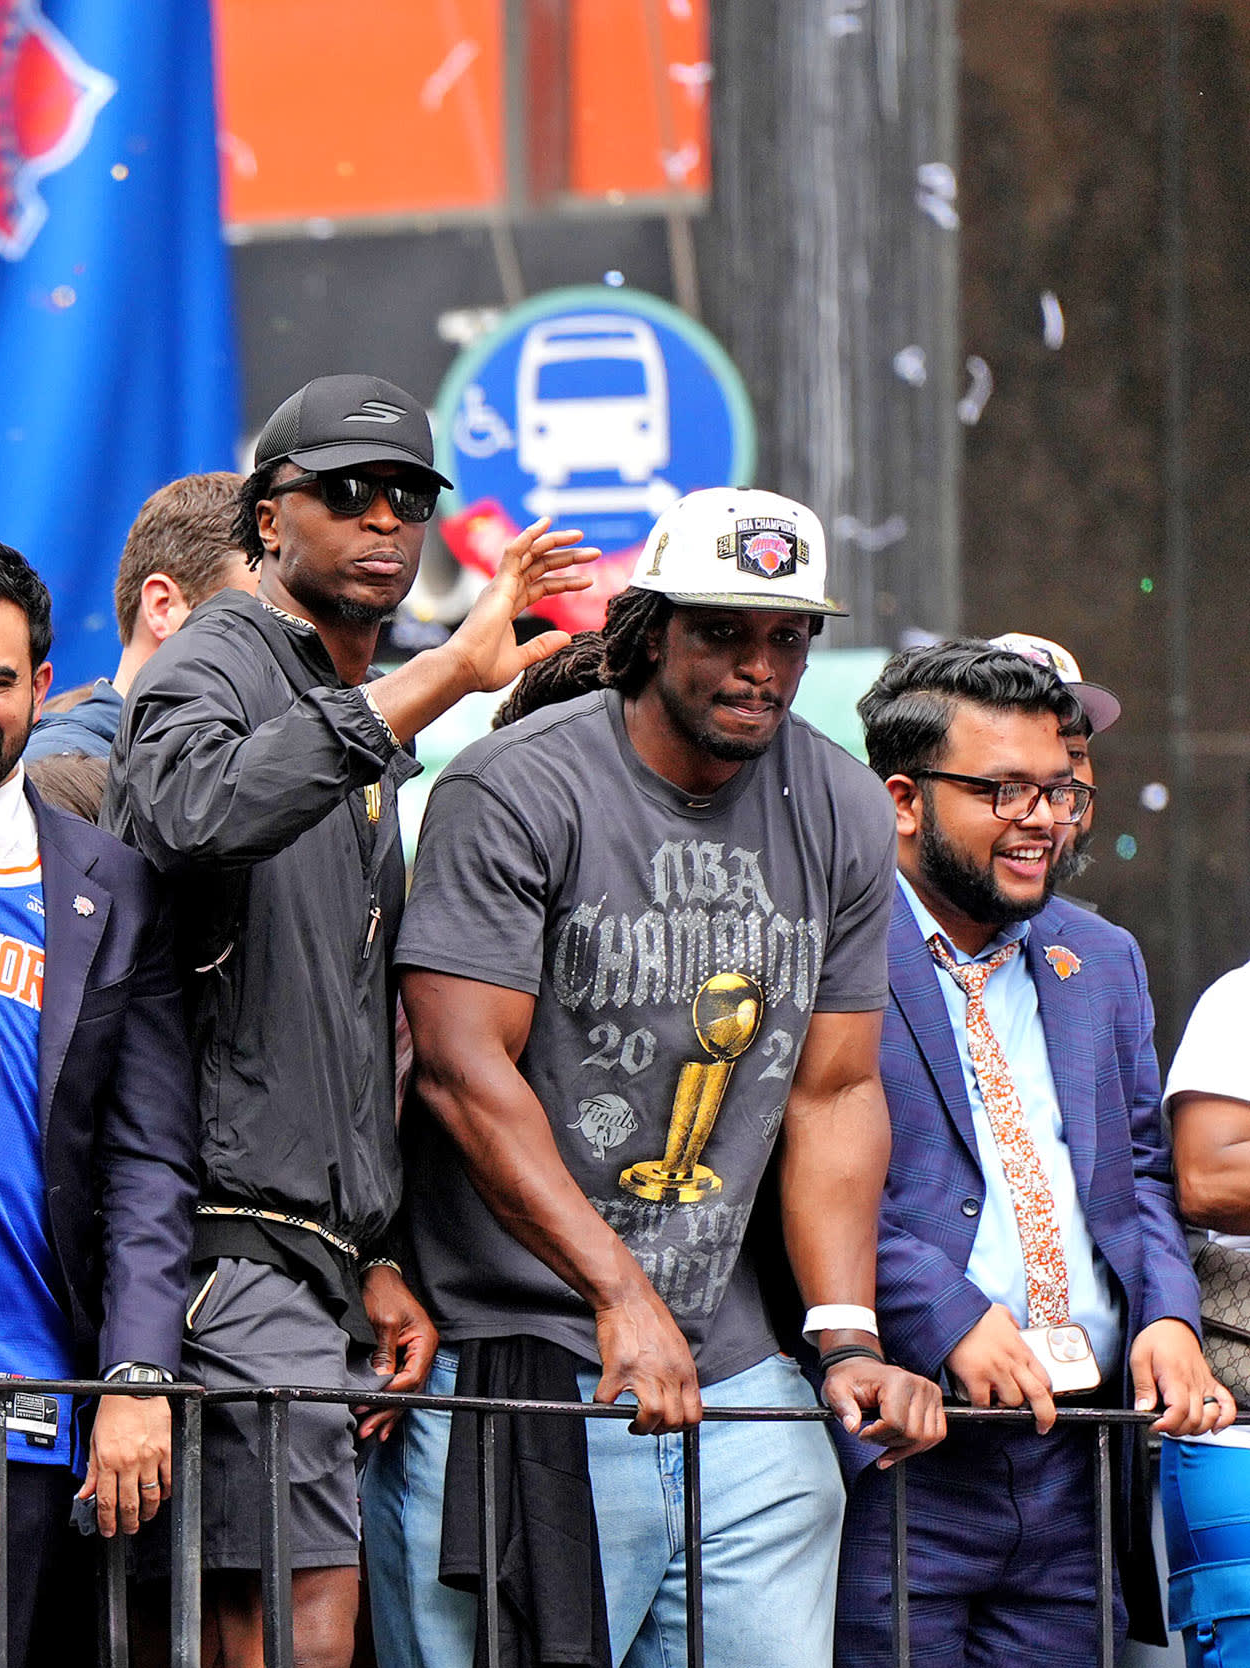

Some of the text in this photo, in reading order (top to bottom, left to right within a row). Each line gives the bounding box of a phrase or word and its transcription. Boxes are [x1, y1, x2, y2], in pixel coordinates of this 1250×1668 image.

[737, 518, 796, 533] NBA CHAMPIONS
[651, 839, 775, 917] NBA
[581, 1021, 657, 1076] 20
[567, 1098, 639, 1133] Finals
